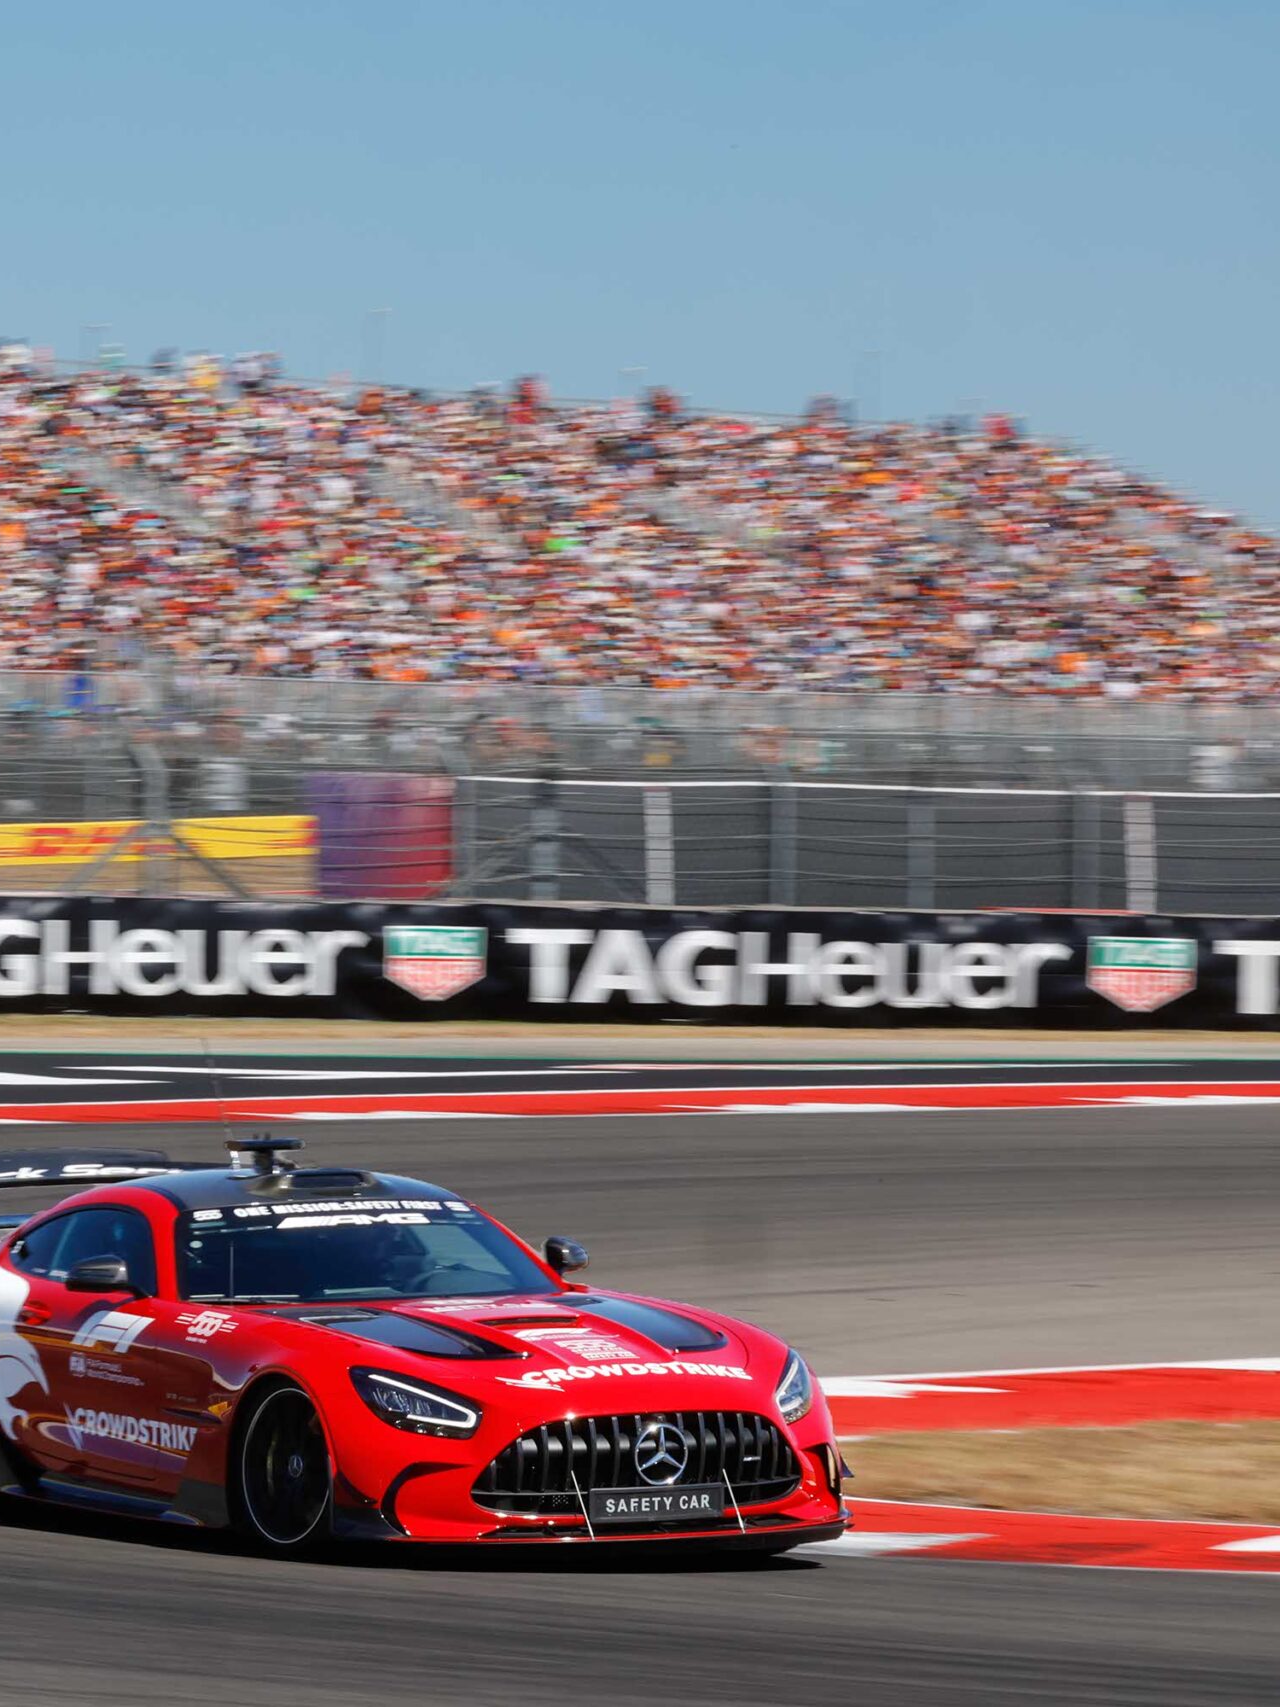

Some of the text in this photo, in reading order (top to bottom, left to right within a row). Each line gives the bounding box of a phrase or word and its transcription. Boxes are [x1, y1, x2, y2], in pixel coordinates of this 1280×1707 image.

[233, 1205, 272, 1218] ONE
[326, 1212, 431, 1228] AMG
[521, 1360, 753, 1385] CROWDSTRIKE
[605, 1494, 710, 1513] SAFETY CAR
